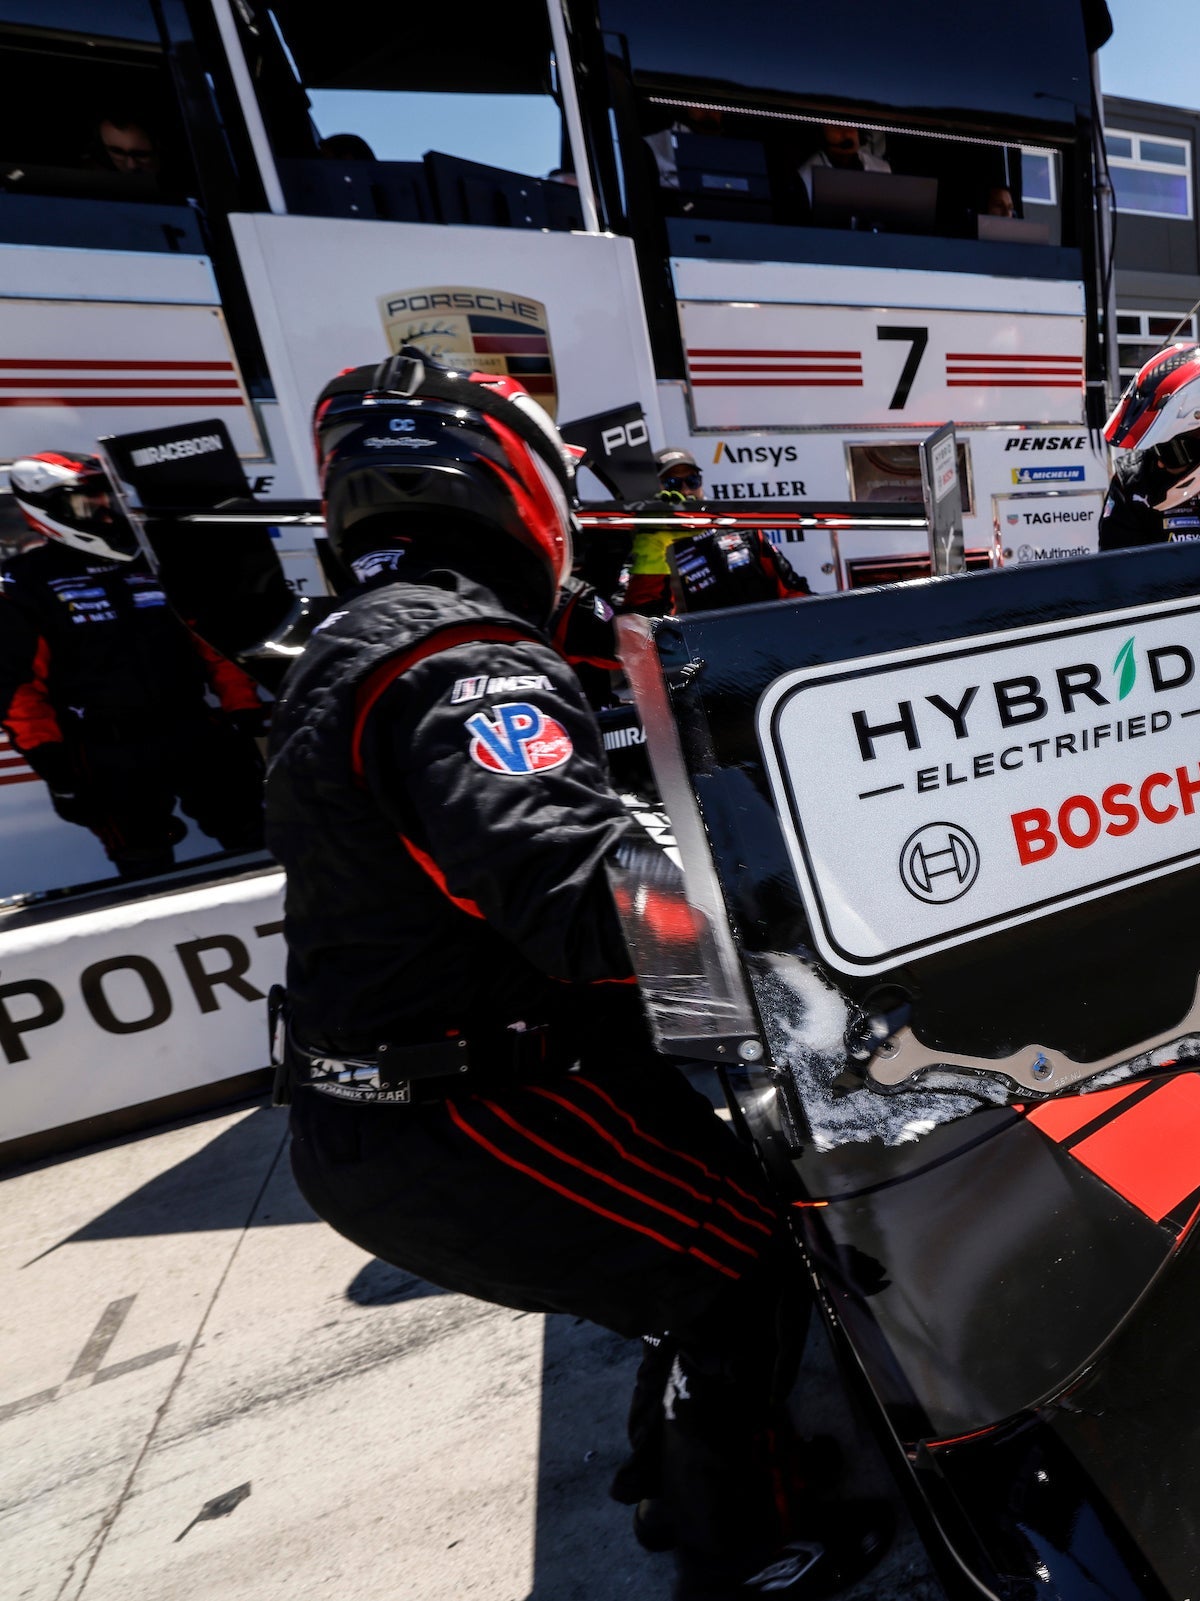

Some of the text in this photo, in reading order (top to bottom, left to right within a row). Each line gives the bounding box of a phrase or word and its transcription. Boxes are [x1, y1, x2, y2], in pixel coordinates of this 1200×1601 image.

[387, 293, 539, 321] PORSCHE
[876, 326, 928, 410] 7
[149, 434, 223, 463] RACEBORN
[601, 419, 649, 456] PO
[1004, 436, 1088, 451] PENSKE
[712, 442, 798, 467] Ansys
[1032, 470, 1080, 479] MICHELIN
[711, 481, 807, 500] HELLER
[1035, 546, 1090, 560] Multimatic
[486, 675, 557, 694] IMSA
[464, 703, 540, 772] VP
[917, 710, 1172, 793] ELECTRIFIED
